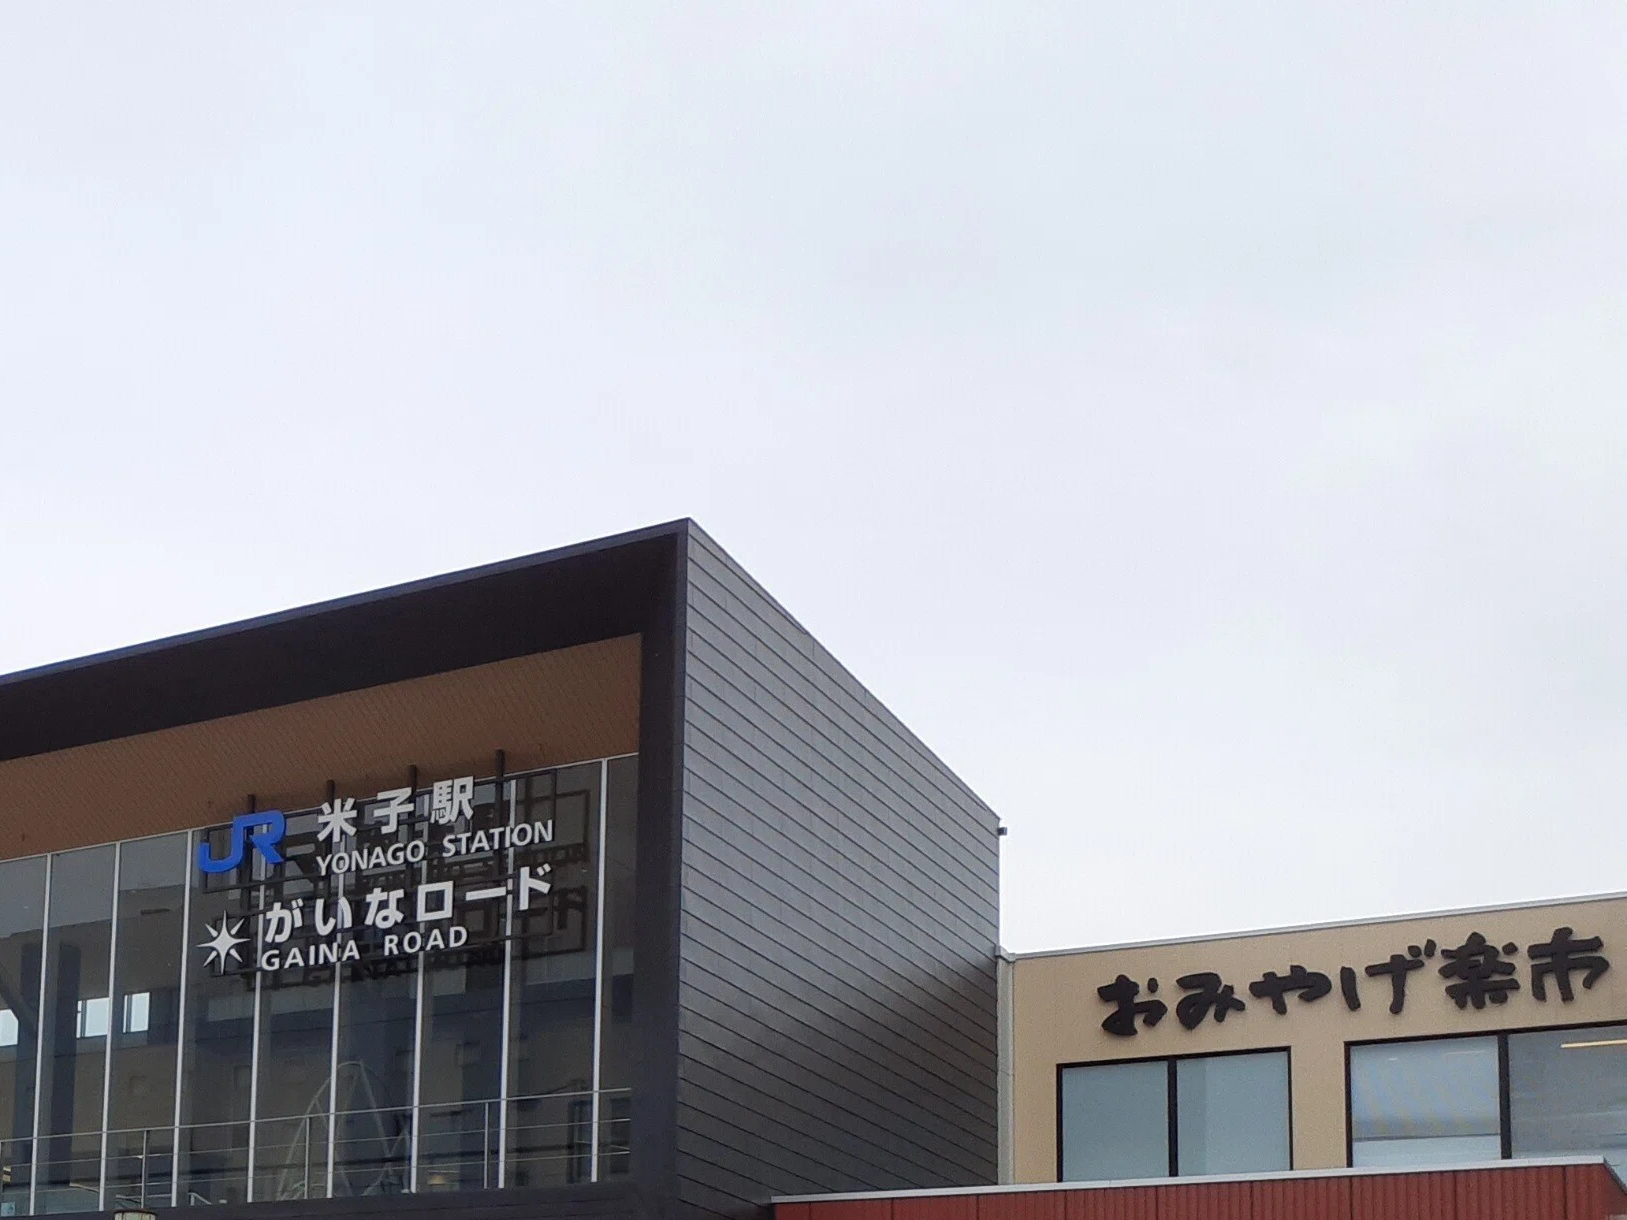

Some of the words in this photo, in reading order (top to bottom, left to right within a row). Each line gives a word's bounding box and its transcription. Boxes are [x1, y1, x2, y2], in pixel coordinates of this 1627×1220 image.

[198, 809, 287, 874] JR
[316, 776, 474, 844] 米子駅
[316, 839, 424, 877] YONAGO
[442, 819, 554, 858] STATION
[265, 863, 552, 944] がいなロード
[261, 938, 361, 972] GAINA
[384, 925, 468, 957] ROAD
[1096, 926, 1611, 1037] おみやげ楽市
